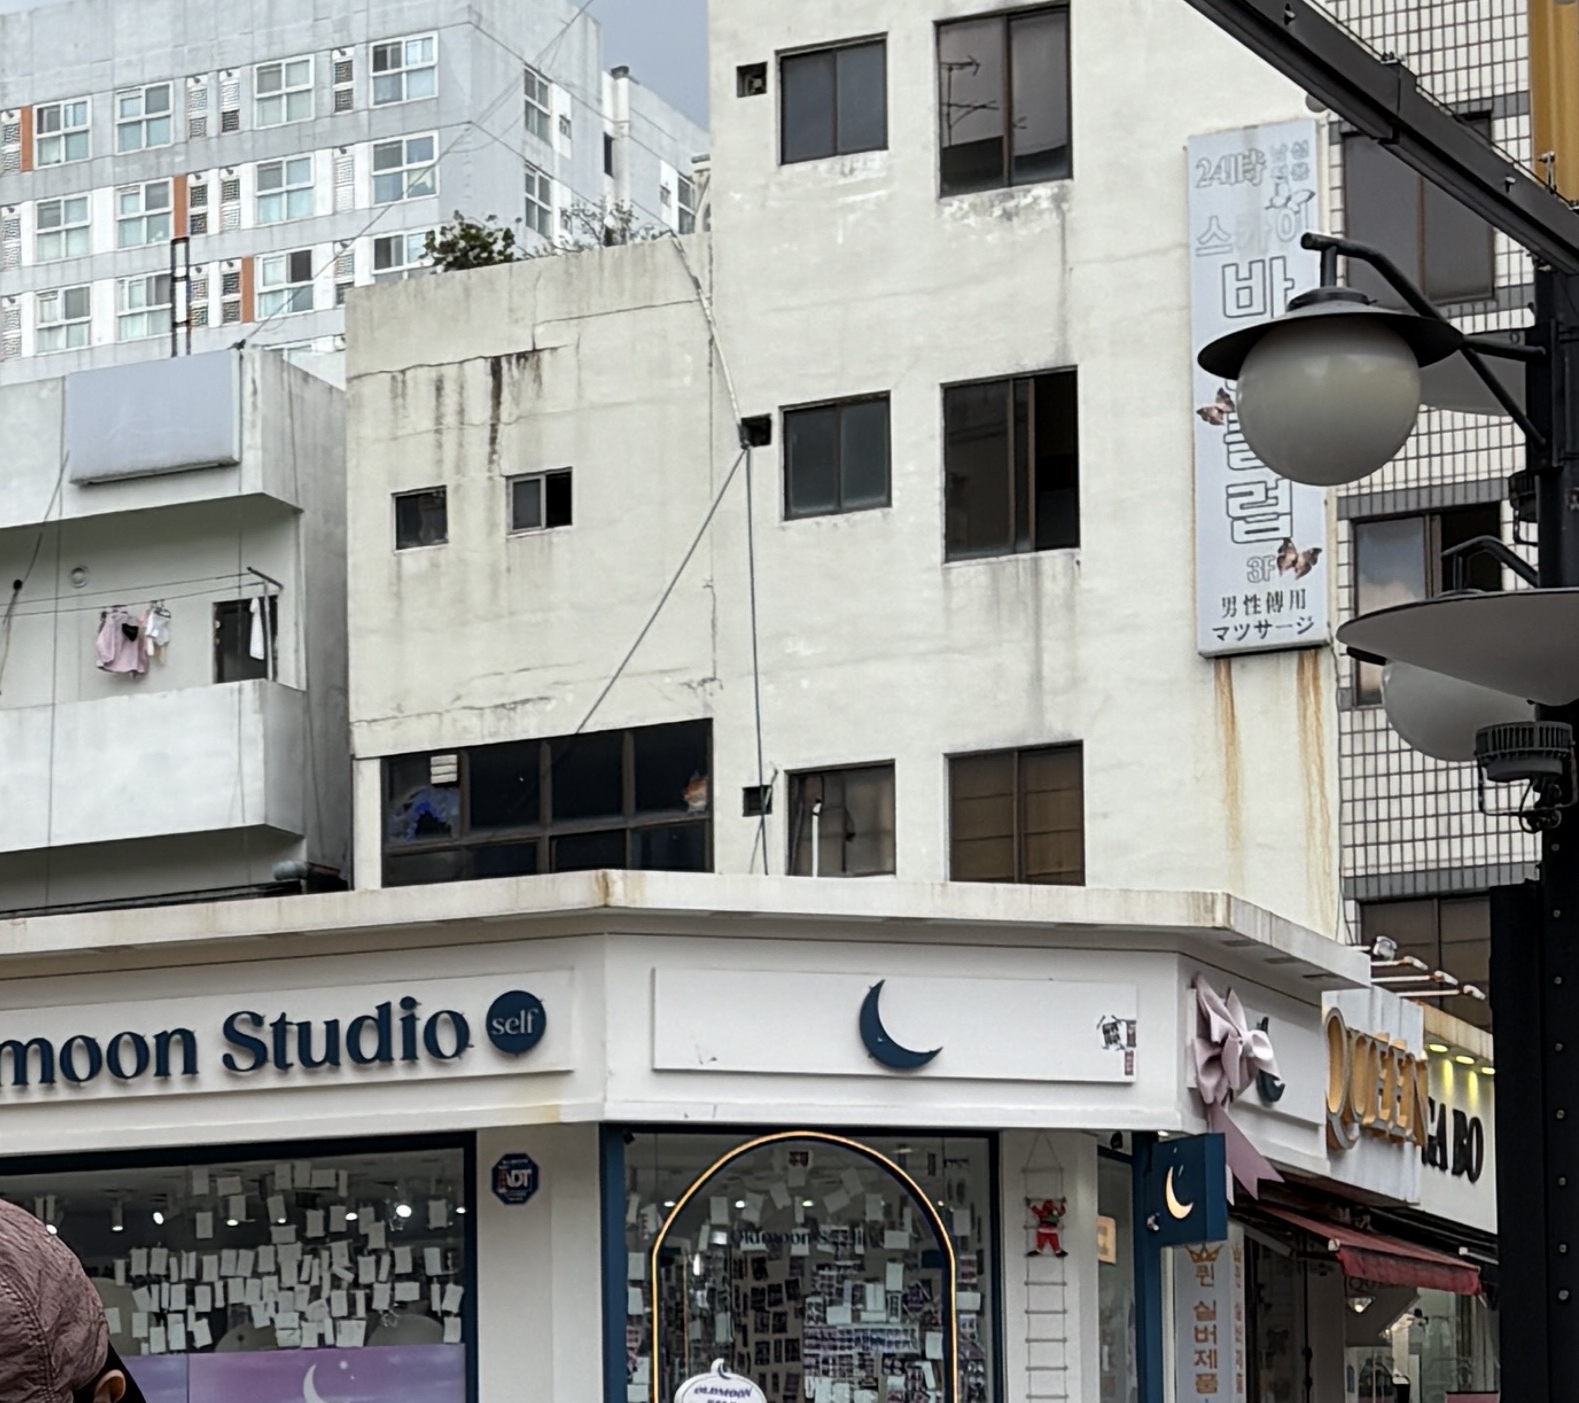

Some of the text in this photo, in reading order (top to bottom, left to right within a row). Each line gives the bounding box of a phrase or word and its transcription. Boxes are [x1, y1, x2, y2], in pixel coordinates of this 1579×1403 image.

[1246, 554, 1277, 584] 3F
[222, 995, 471, 1073] Studio
[489, 1007, 541, 1038] self
